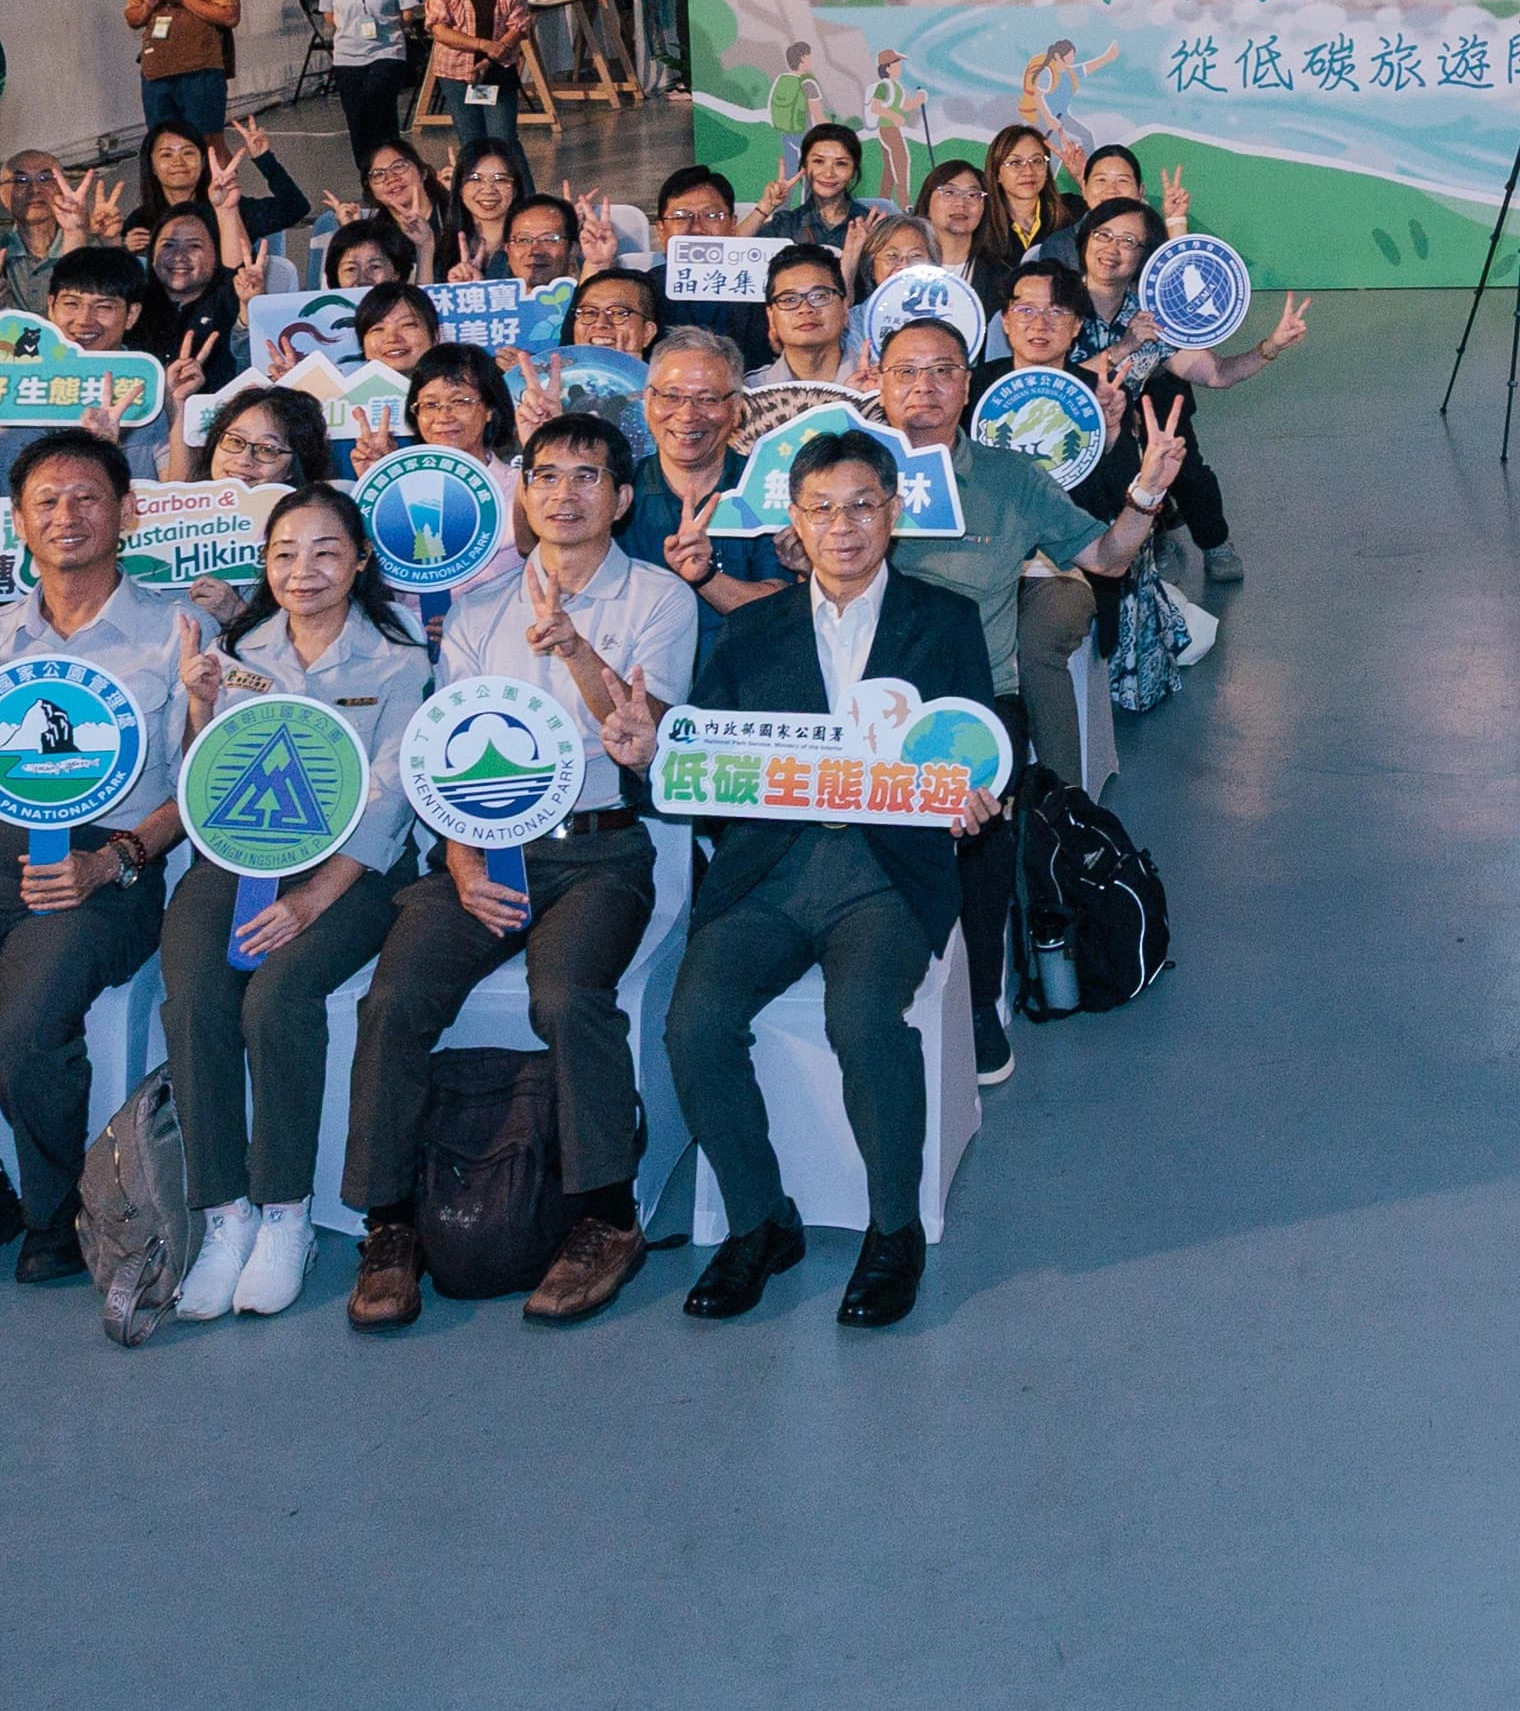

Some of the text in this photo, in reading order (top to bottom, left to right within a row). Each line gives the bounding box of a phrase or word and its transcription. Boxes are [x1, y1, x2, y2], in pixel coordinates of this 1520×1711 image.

[673, 267, 767, 296] 晶淨集
[135, 490, 236, 516] Carbon &
[174, 539, 267, 579] Hiking
[411, 559, 470, 581] NATIONAL
[469, 531, 492, 559] PARK
[223, 704, 346, 744] 陽明山國家公園
[409, 684, 574, 770] 墾丁國家公園管理處
[704, 719, 845, 742] 內政部國家公園署
[20, 799, 99, 820] NATIONAL
[99, 770, 128, 801] PARK
[411, 758, 575, 841] KENTING NATIONAL PARK
[660, 749, 971, 817] 低碳生態旅遊
[210, 833, 324, 867] YANGMINGSHAN N P
